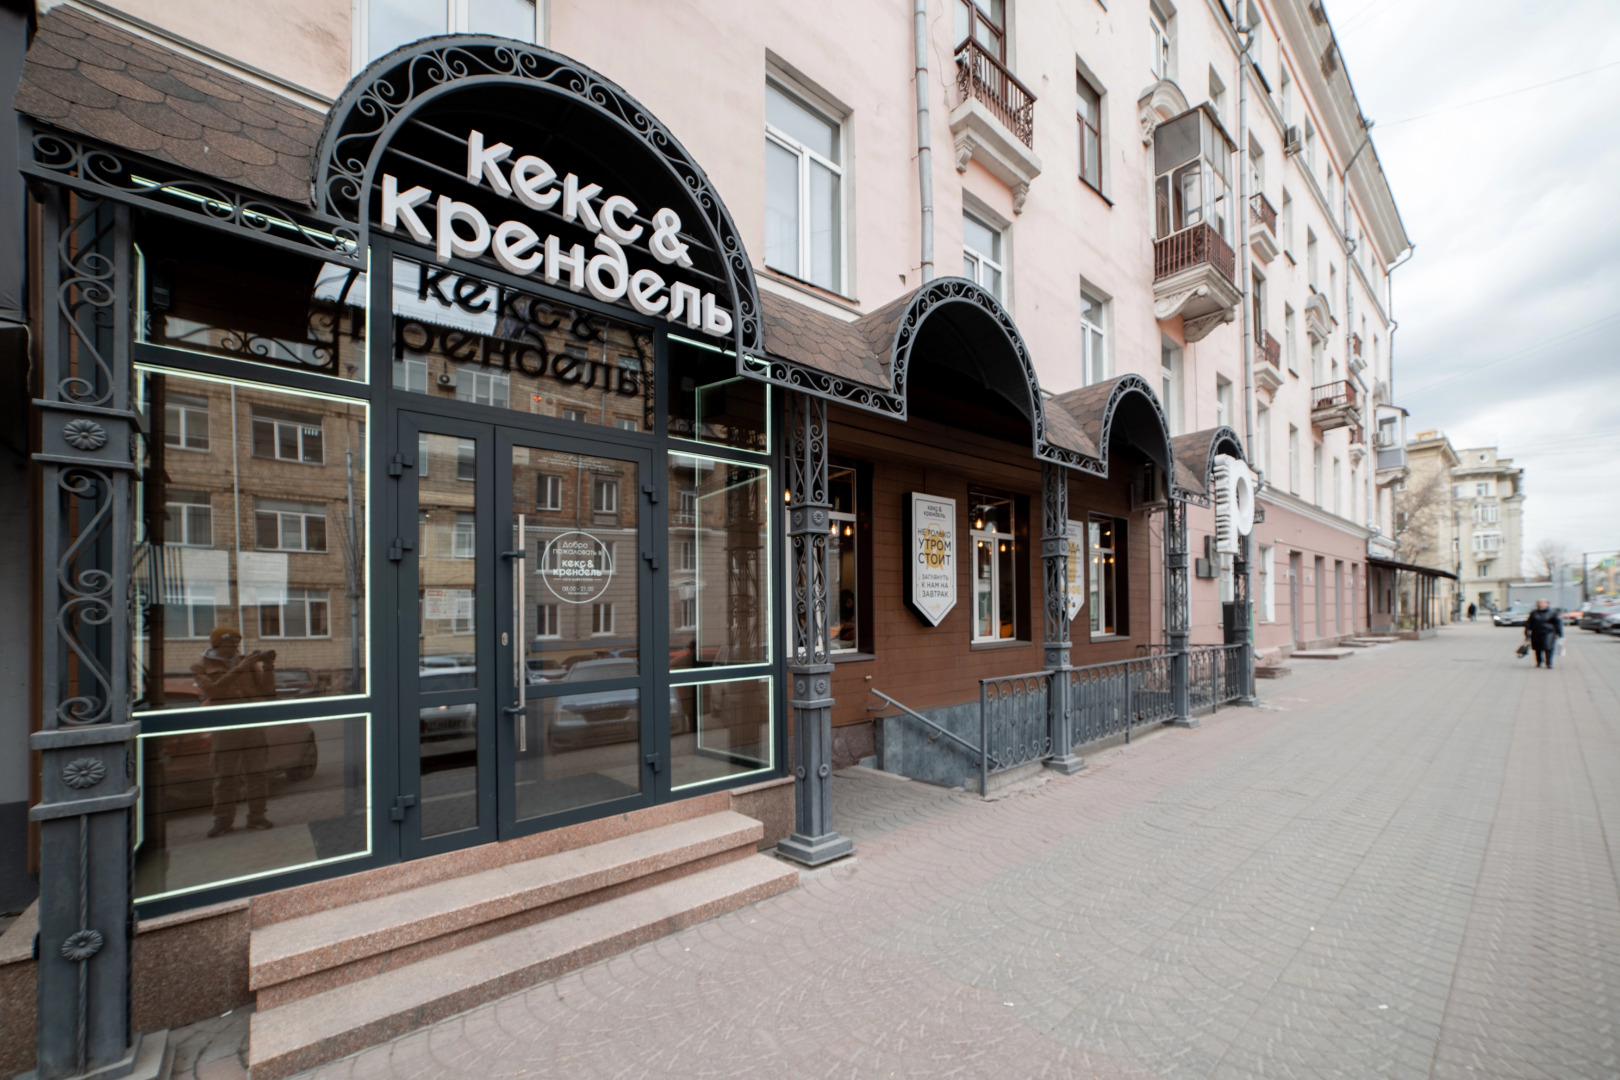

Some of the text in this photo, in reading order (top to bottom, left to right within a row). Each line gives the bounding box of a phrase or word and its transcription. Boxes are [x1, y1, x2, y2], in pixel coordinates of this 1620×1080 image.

[467, 129, 694, 269] кекс &
[381, 173, 734, 337] крендель
[562, 541, 589, 550] Добро
[918, 538, 951, 552] УТРОМ
[552, 548, 597, 556] пожаловать
[562, 559, 595, 569] кекс &
[918, 552, 951, 566] СТОИТ
[552, 567, 602, 577] крендель
[921, 573, 949, 581] ЗАГЛЯНУТЬ
[921, 590, 949, 598] ЗАВТРАК
